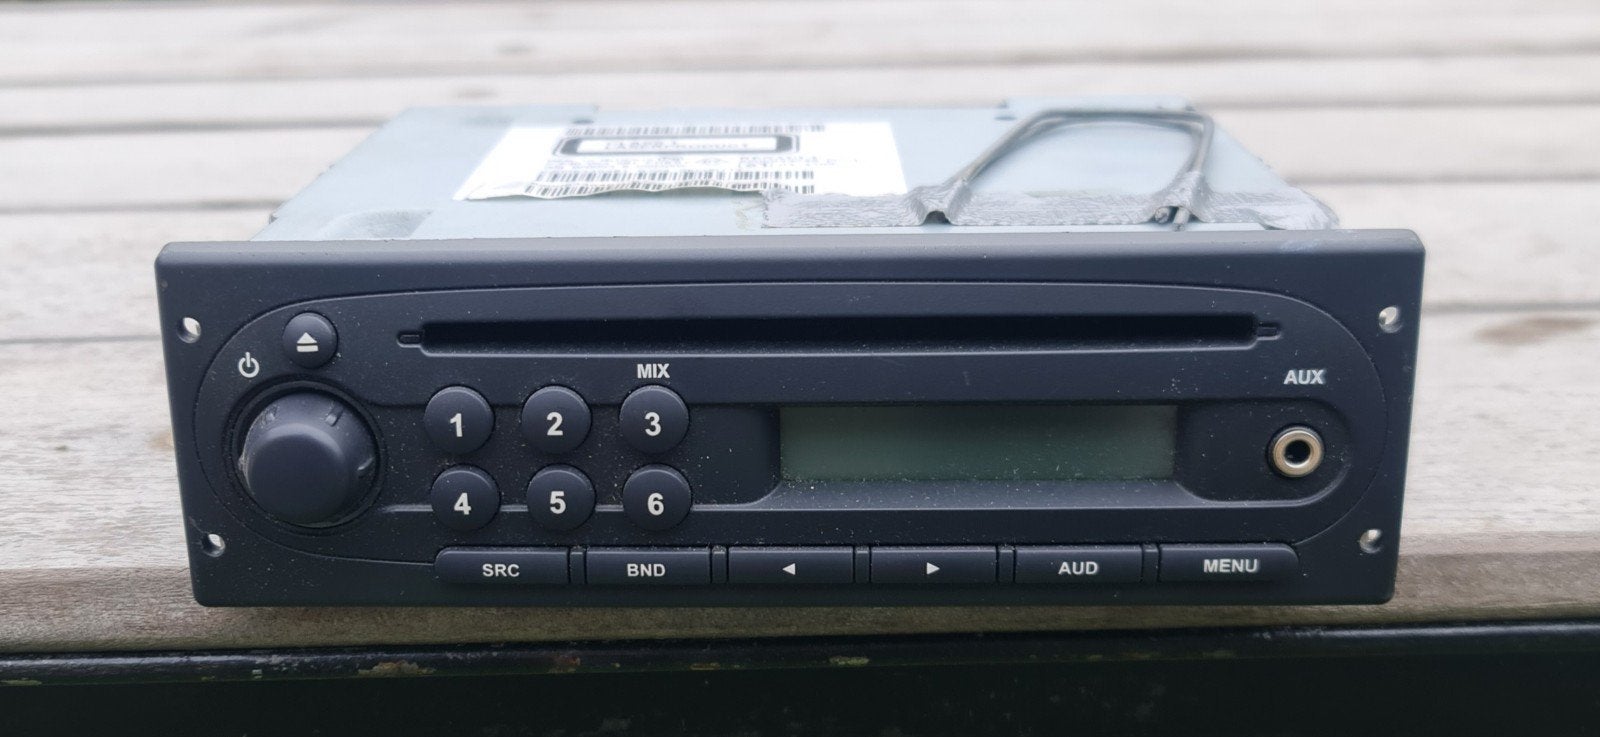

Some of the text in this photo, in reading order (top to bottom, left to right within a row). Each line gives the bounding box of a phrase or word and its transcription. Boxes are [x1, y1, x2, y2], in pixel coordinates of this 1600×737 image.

[636, 363, 671, 379] MIX
[1283, 369, 1326, 385] AUX
[449, 412, 463, 437] 1
[546, 411, 564, 436] 2
[644, 411, 662, 437] 3
[453, 492, 472, 515] 4
[549, 490, 567, 515] 5
[647, 492, 665, 516] 6
[482, 563, 520, 578] SRC
[626, 563, 666, 578] BND
[1058, 561, 1099, 576] AUD
[1203, 558, 1259, 574] MENU
